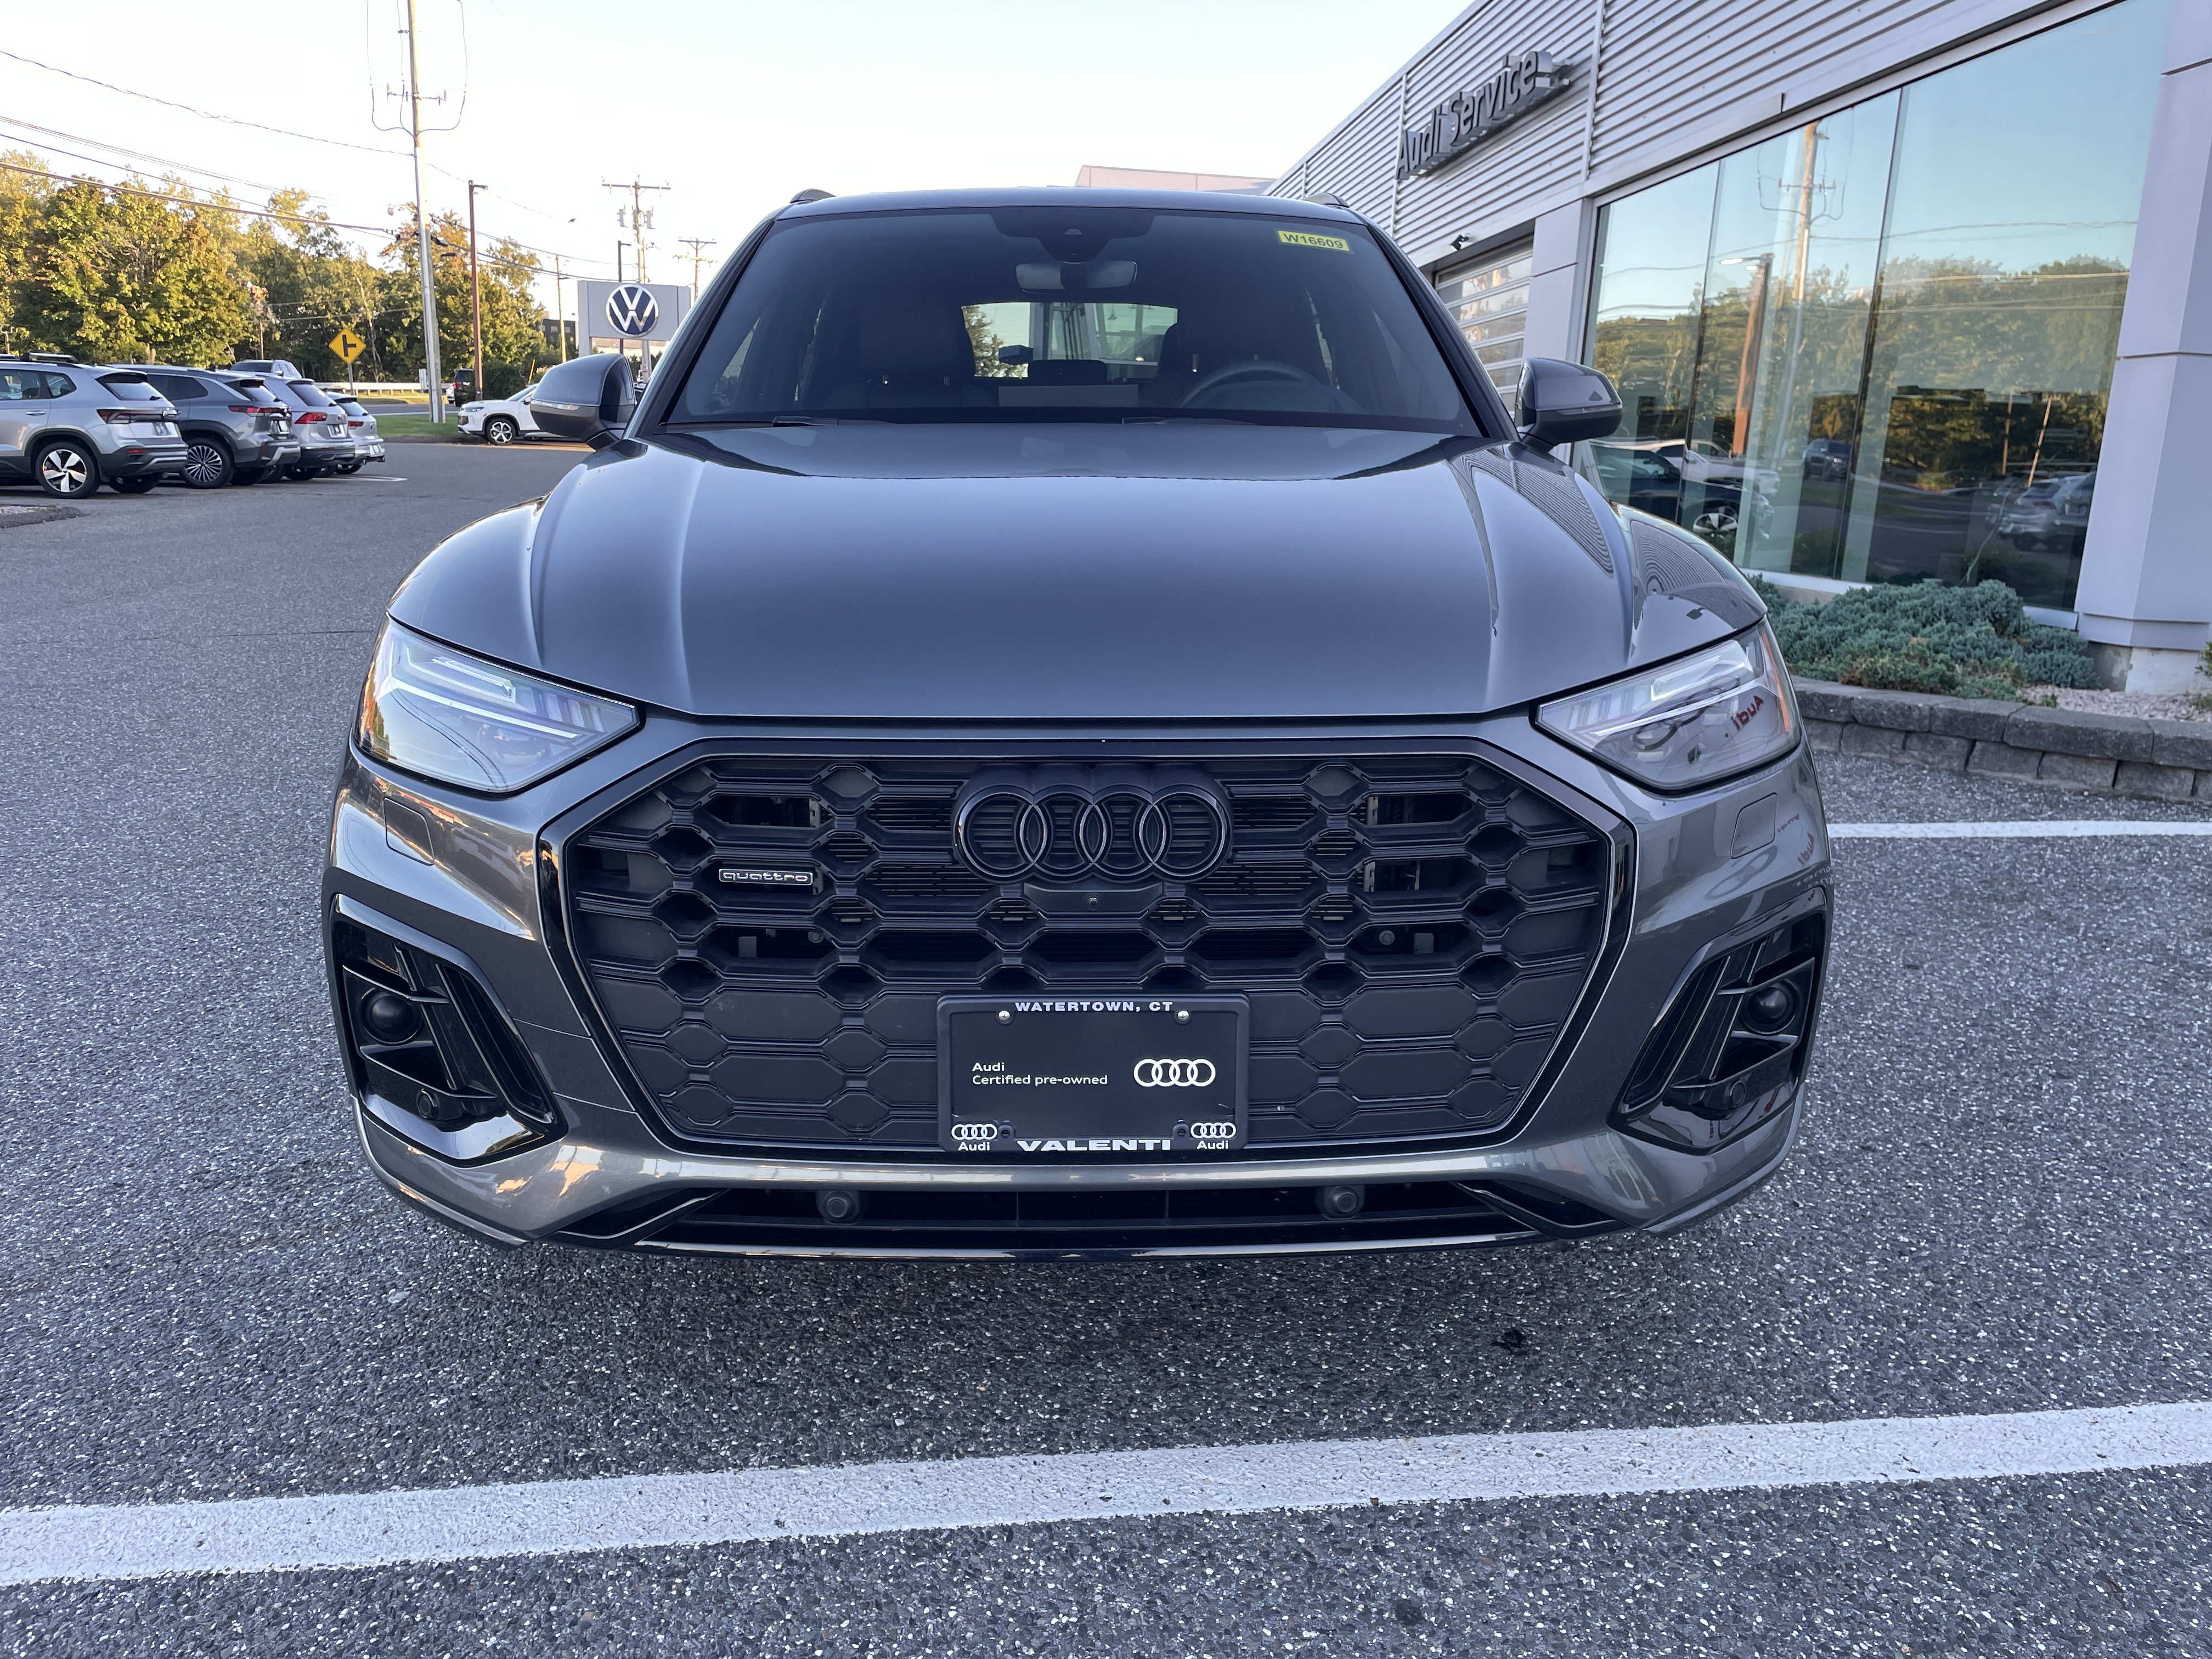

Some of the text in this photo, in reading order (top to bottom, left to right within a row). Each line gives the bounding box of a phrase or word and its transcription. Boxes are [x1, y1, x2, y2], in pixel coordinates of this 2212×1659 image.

[1395, 51, 1541, 179] Audi Service
[1283, 233, 1343, 249] W16609
[723, 872, 808, 882] quattro
[1015, 1001, 1173, 1012] WATERTOWN, CT
[972, 1062, 1005, 1072] Audi
[972, 1075, 1108, 1086] Certified pre-owned
[958, 1141, 991, 1151] Audi
[1017, 1139, 1171, 1152] VALENTI
[1197, 1140, 1229, 1150] Audi
